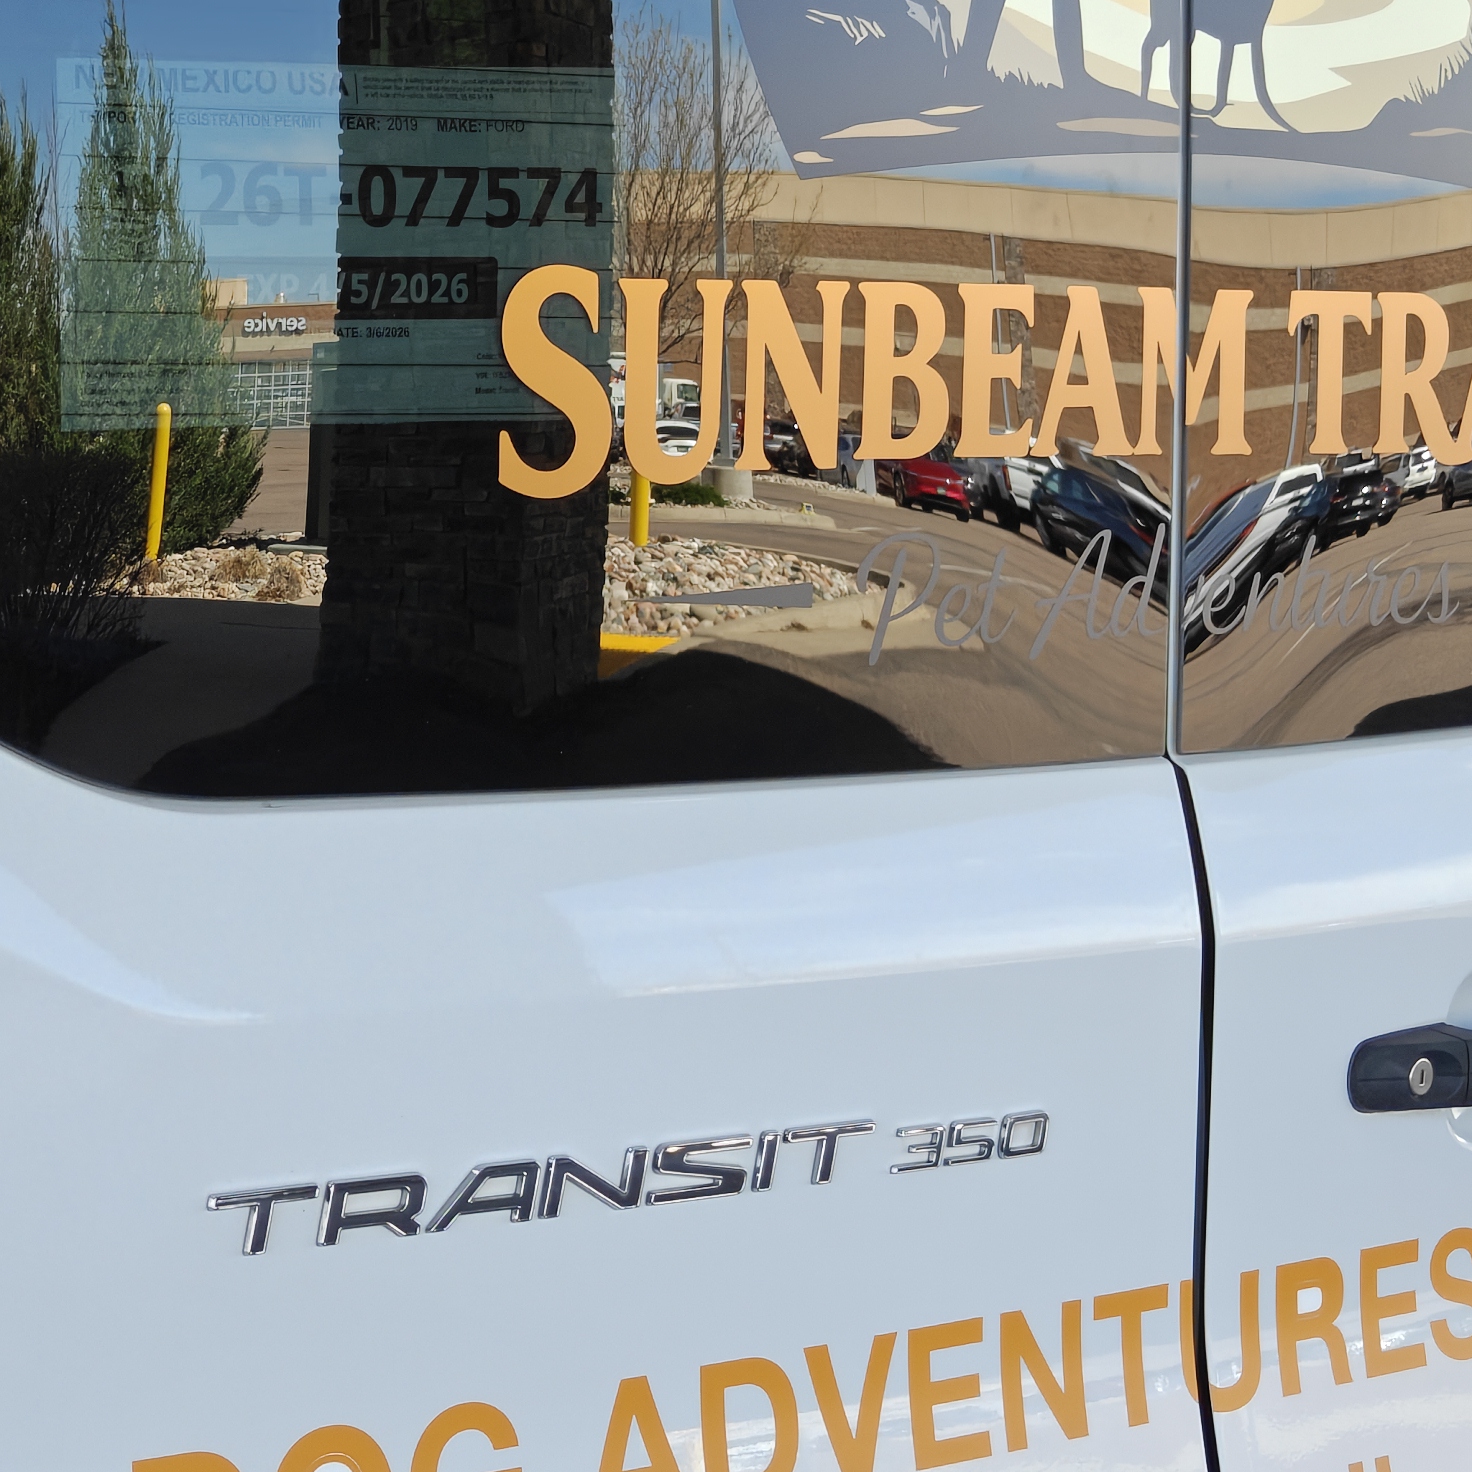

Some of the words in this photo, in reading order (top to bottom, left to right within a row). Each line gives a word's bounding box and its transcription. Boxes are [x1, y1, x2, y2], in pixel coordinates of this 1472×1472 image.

[156, 67, 277, 95] MEXICO
[288, 68, 349, 97] USA
[274, 114, 323, 129] PERMIT
[338, 116, 381, 132] YEAR:
[387, 117, 418, 132] 2019
[437, 118, 482, 134] MAKE:
[486, 119, 526, 133] FORD
[199, 160, 604, 229] 26T-077574
[365, 325, 410, 339] 3/6/2026
[498, 263, 1254, 500] SUNBEAM
[856, 530, 1015, 667] Pet
[206, 1118, 877, 1258] TRANSIT
[889, 1109, 1052, 1176] 350
